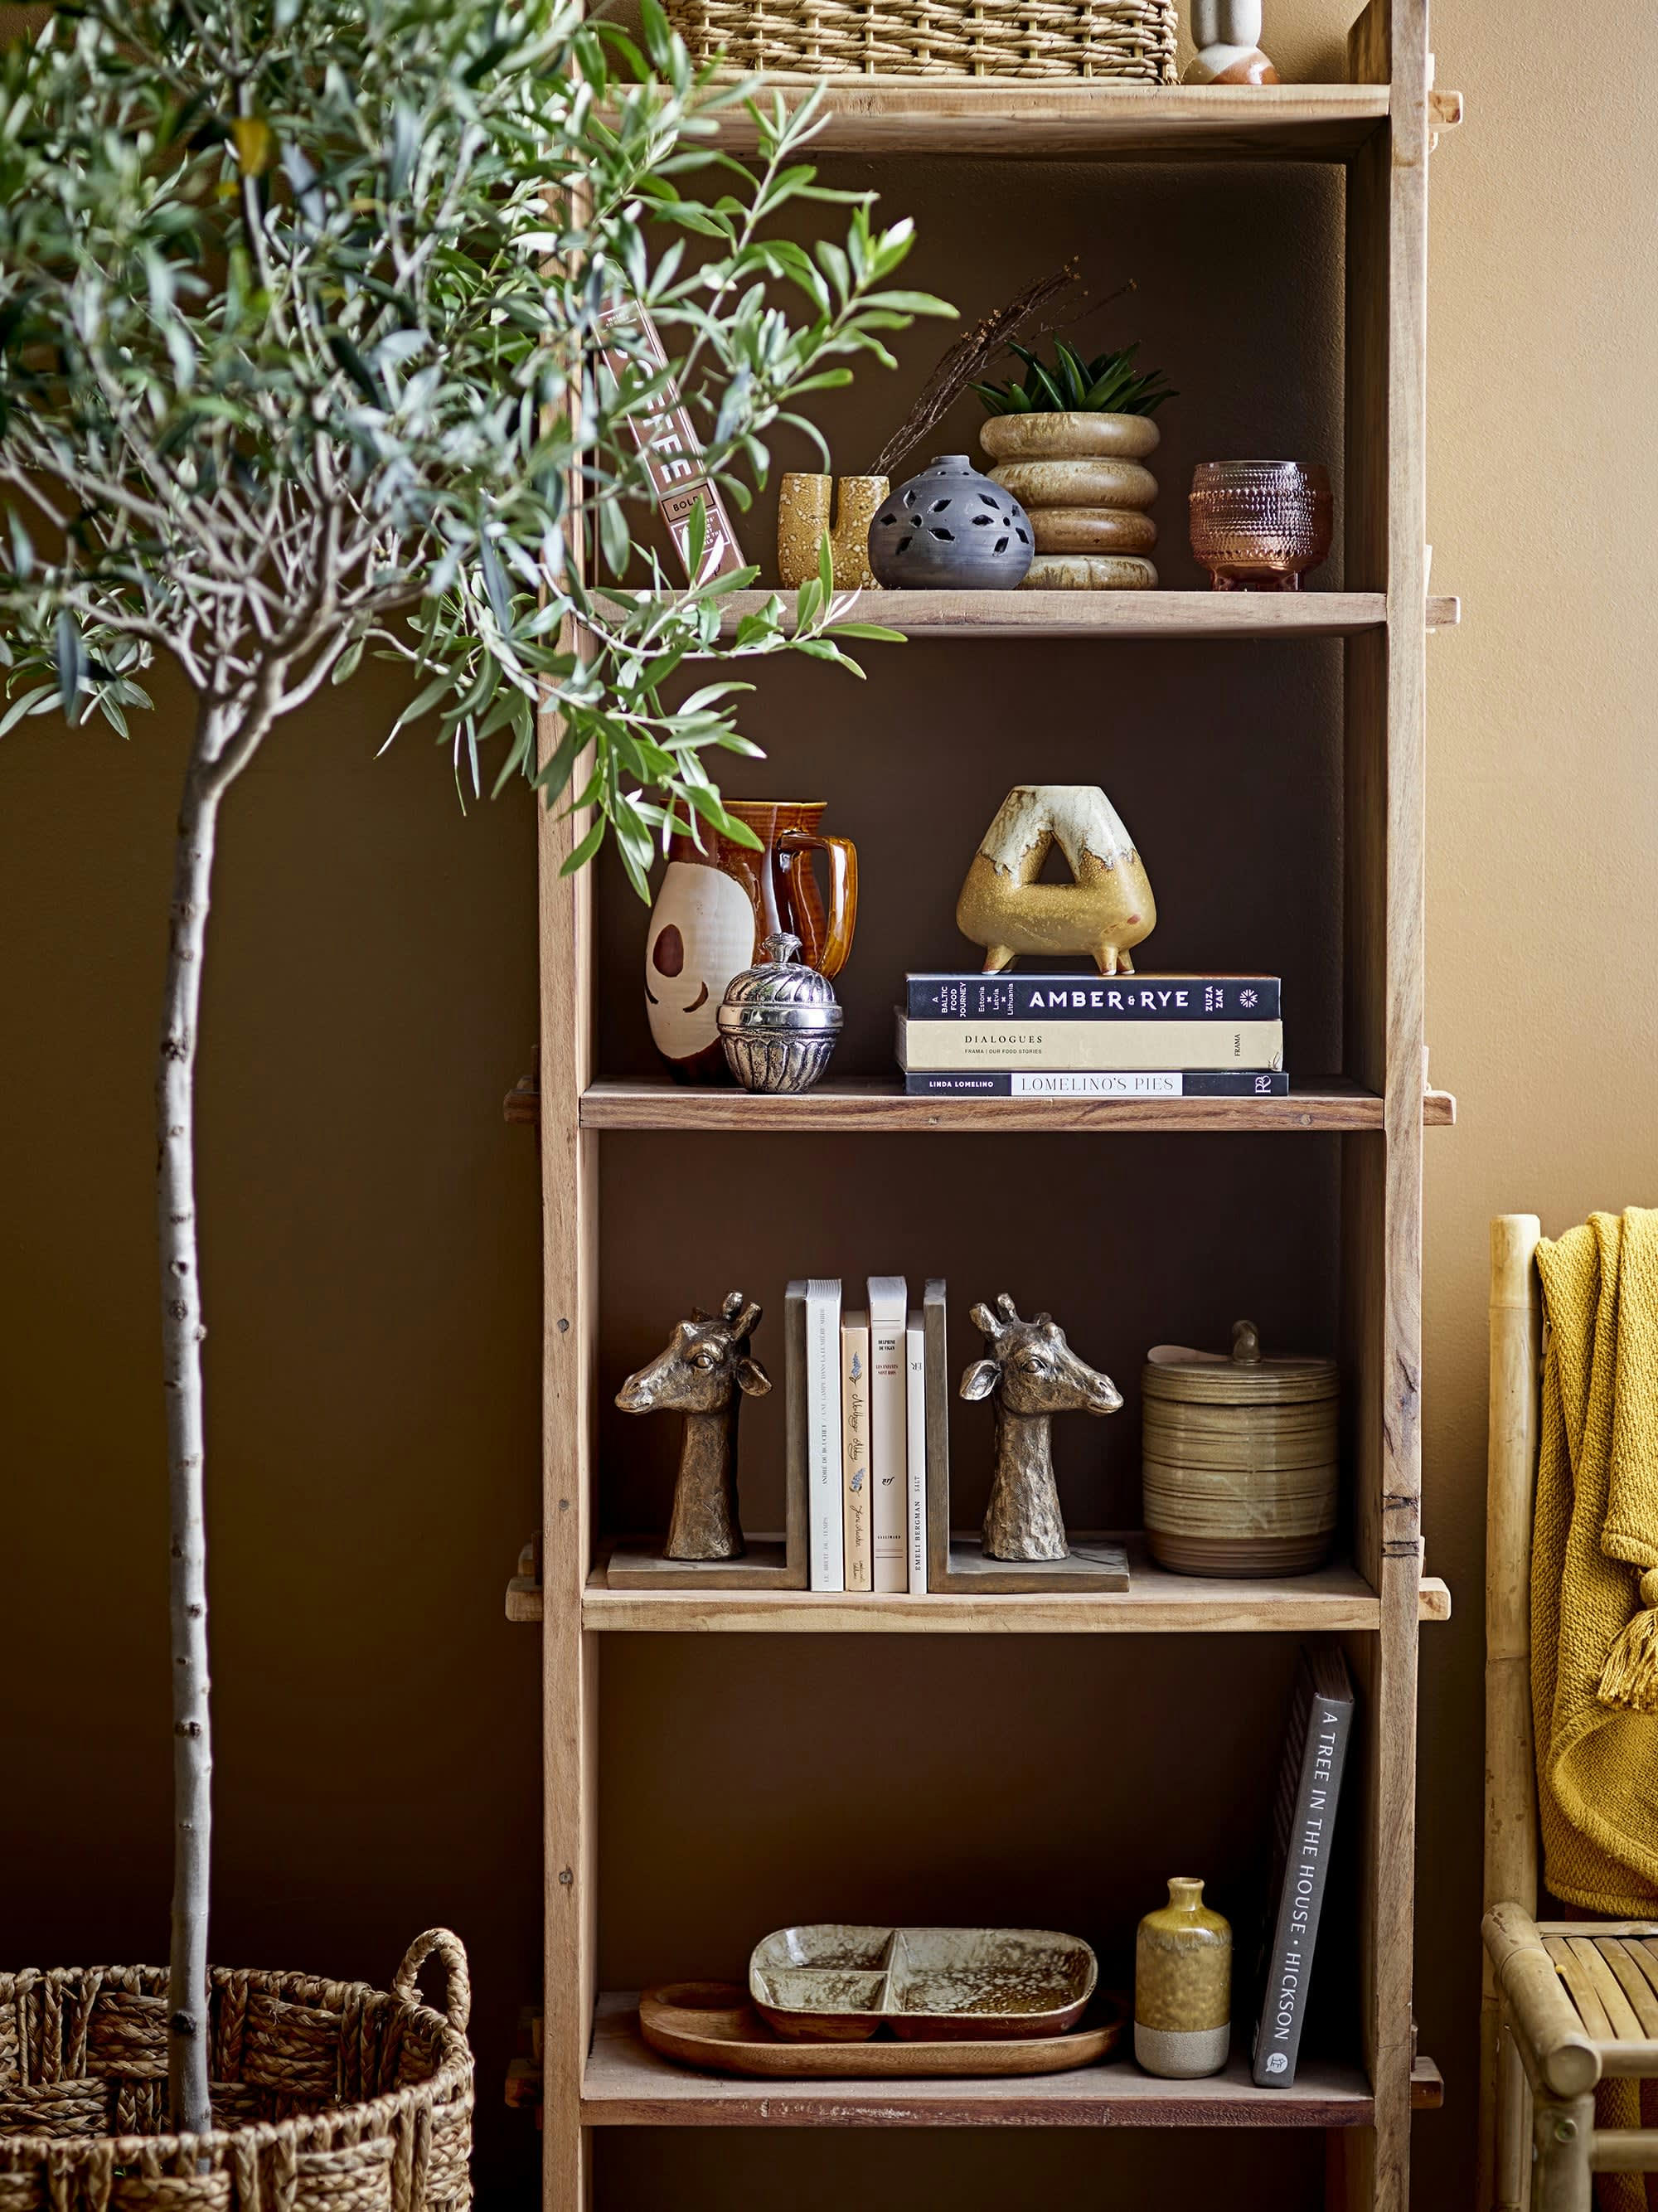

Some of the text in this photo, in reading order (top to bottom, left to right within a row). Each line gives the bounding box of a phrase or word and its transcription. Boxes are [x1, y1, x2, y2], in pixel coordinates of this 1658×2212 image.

[1029, 991, 1189, 1010] AMBER & RYE
[1205, 985, 1214, 1012] ZUZA
[1215, 988, 1224, 1008] ZAK
[965, 1036, 1042, 1044] DIALOGUES
[1021, 1077, 1174, 1091] LOMELINO'S PIES
[1274, 1711, 1338, 2040] A TREE IN THE HOUSE HICKSON
